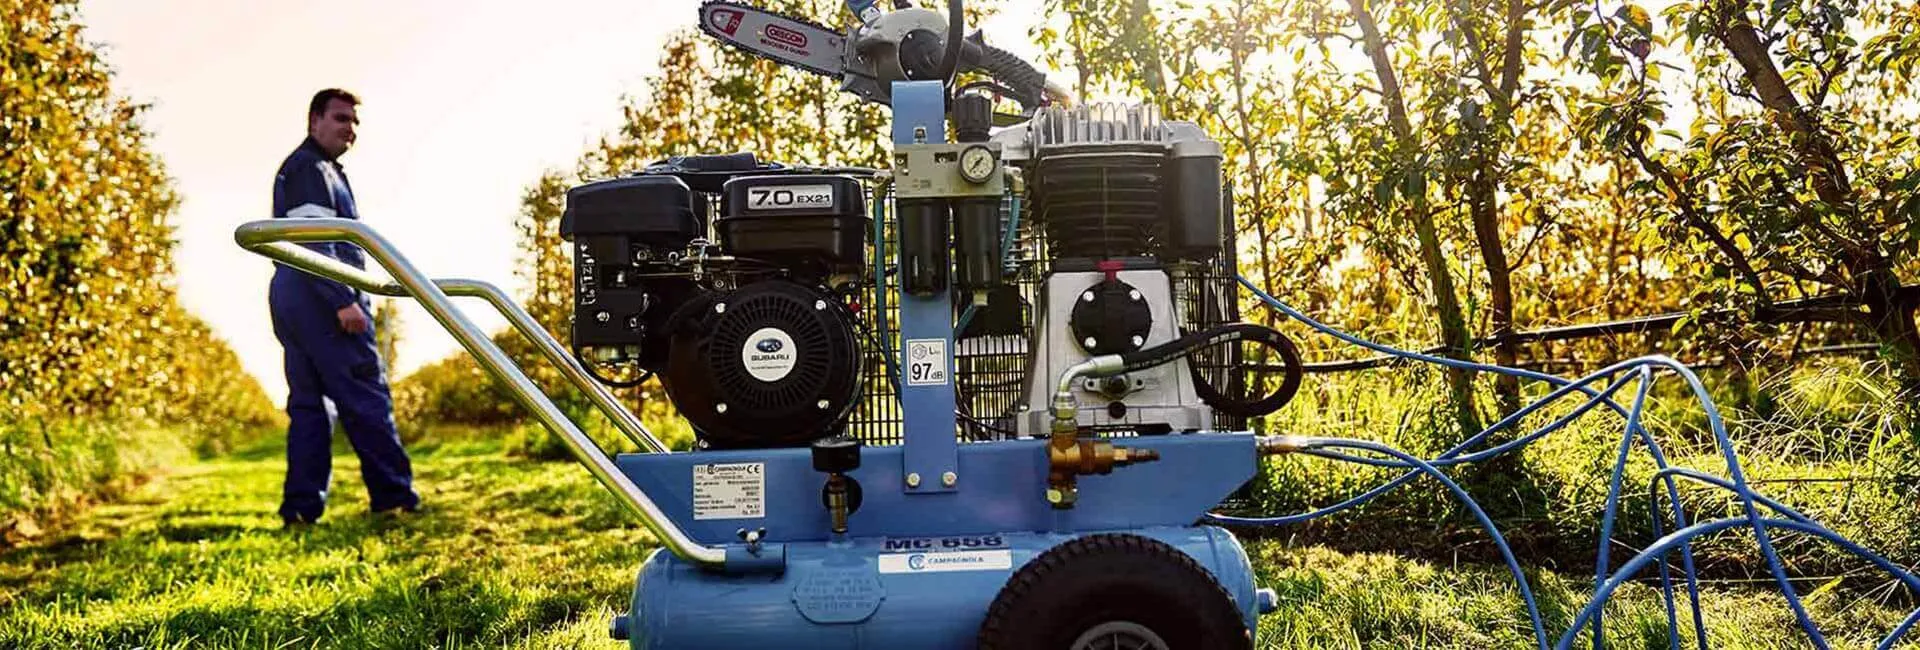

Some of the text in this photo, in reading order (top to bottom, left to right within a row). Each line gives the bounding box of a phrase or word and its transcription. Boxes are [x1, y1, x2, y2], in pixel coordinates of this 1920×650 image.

[769, 28, 803, 43] OREGON
[752, 190, 830, 206] 7.0 EX21
[912, 363, 943, 380] 97 dB
[886, 538, 932, 549] MC
[928, 556, 984, 564] CAMPAGNOLA
